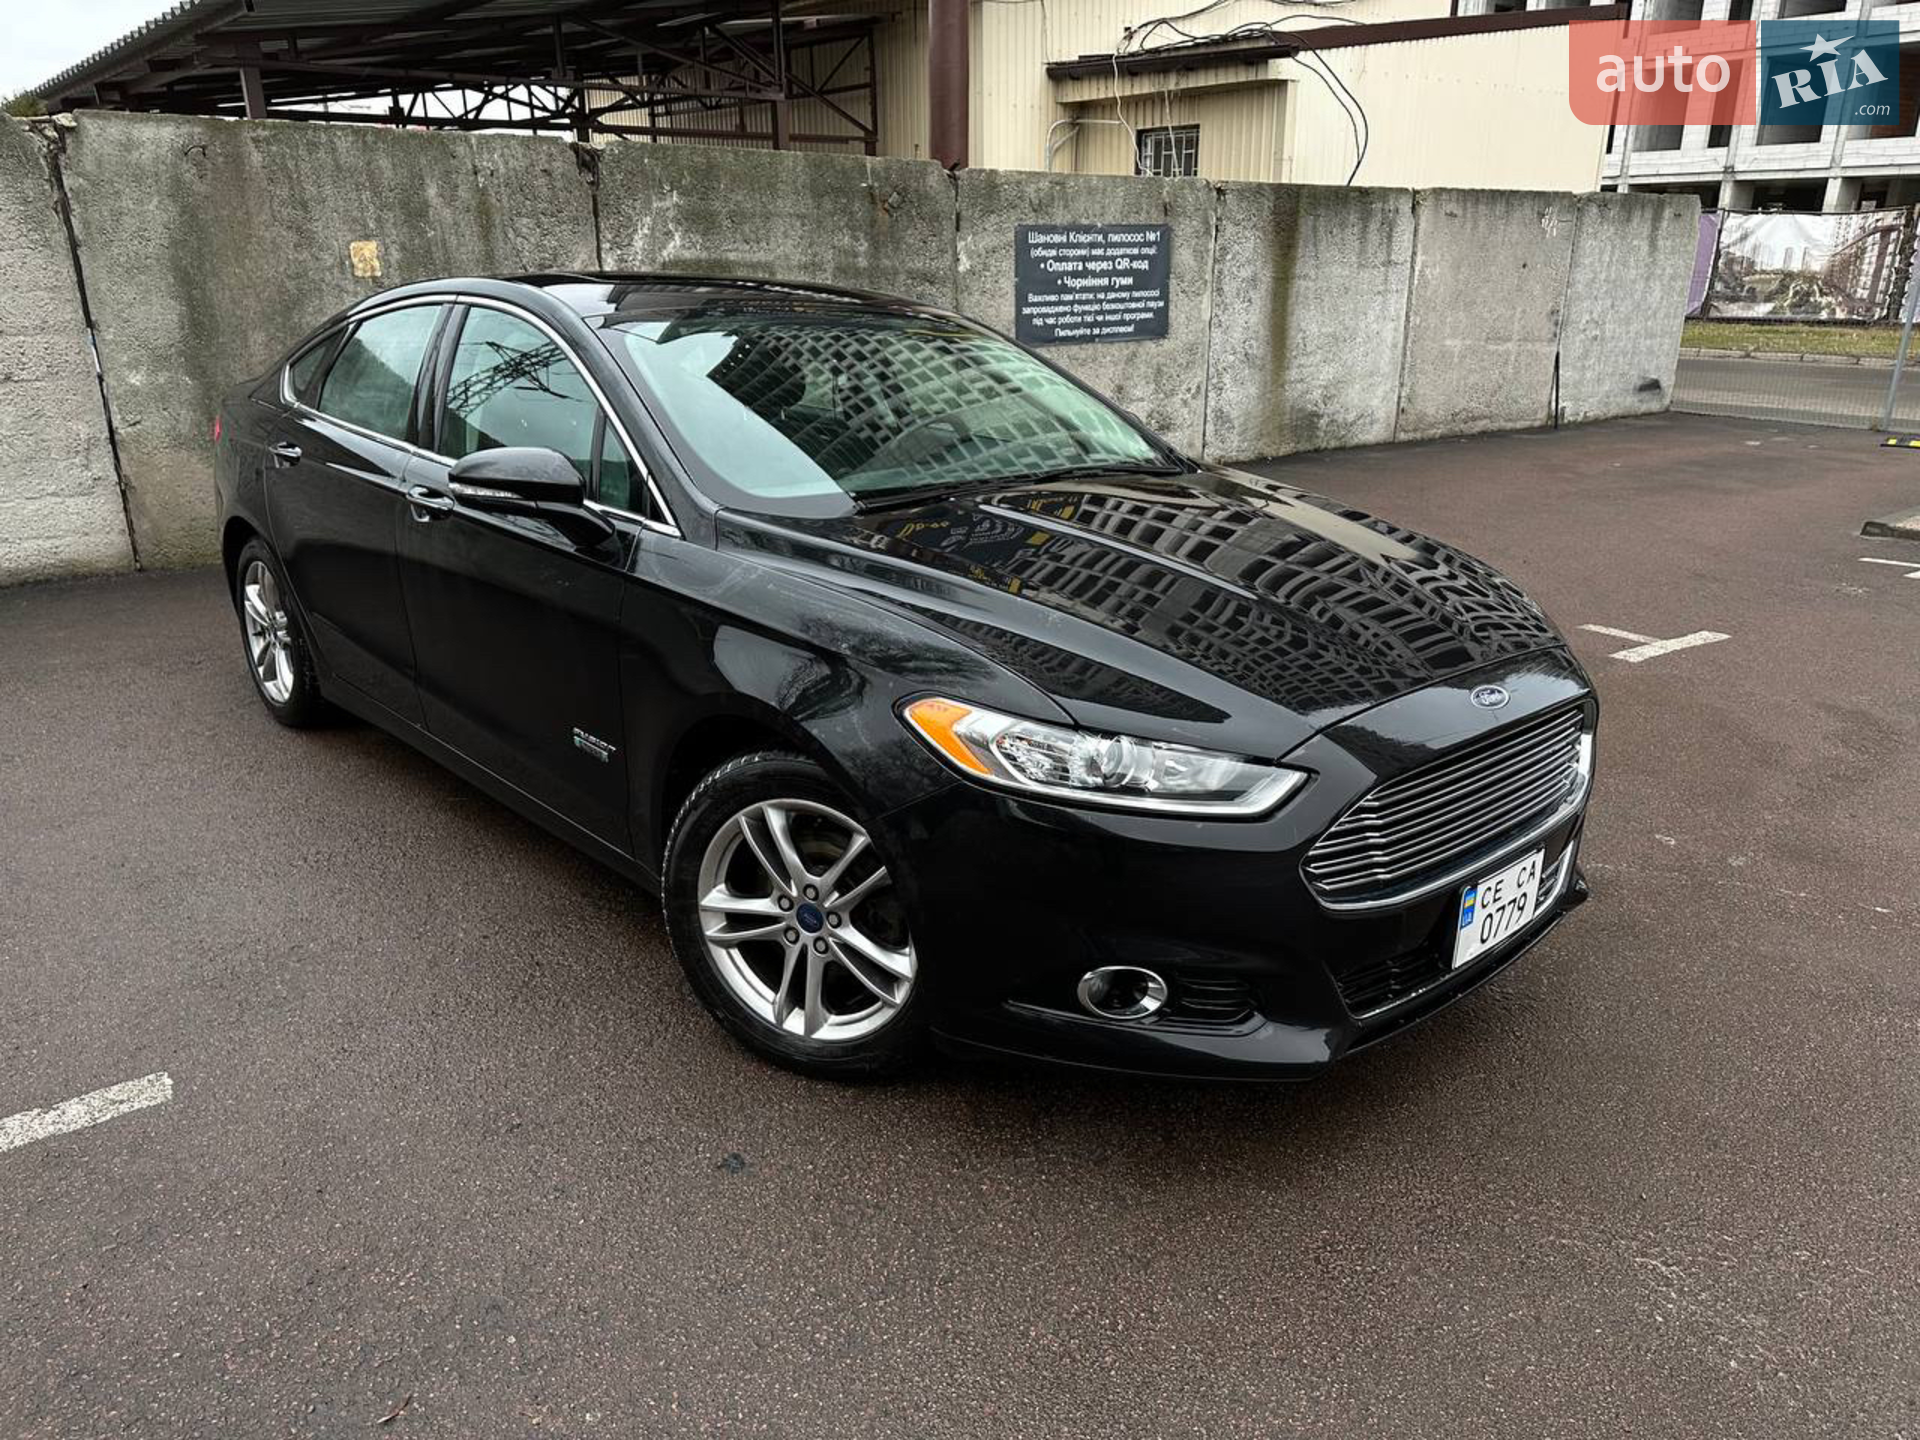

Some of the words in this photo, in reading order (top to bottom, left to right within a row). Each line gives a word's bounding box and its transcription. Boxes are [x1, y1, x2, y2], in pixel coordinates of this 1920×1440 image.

[1029, 231, 1067, 244] Шановні
[1069, 231, 1105, 245] Клієнти,
[1108, 233, 1144, 243] пилосос
[1146, 230, 1160, 242] №1
[1046, 259, 1083, 272] Оплата
[1085, 260, 1113, 273] через
[1115, 258, 1149, 270] QR-код
[1063, 275, 1109, 290] Чорніння
[1111, 277, 1133, 289] гуми
[1481, 879, 1504, 909] CE
[1516, 860, 1536, 889] CA
[1480, 892, 1527, 944] 0779
